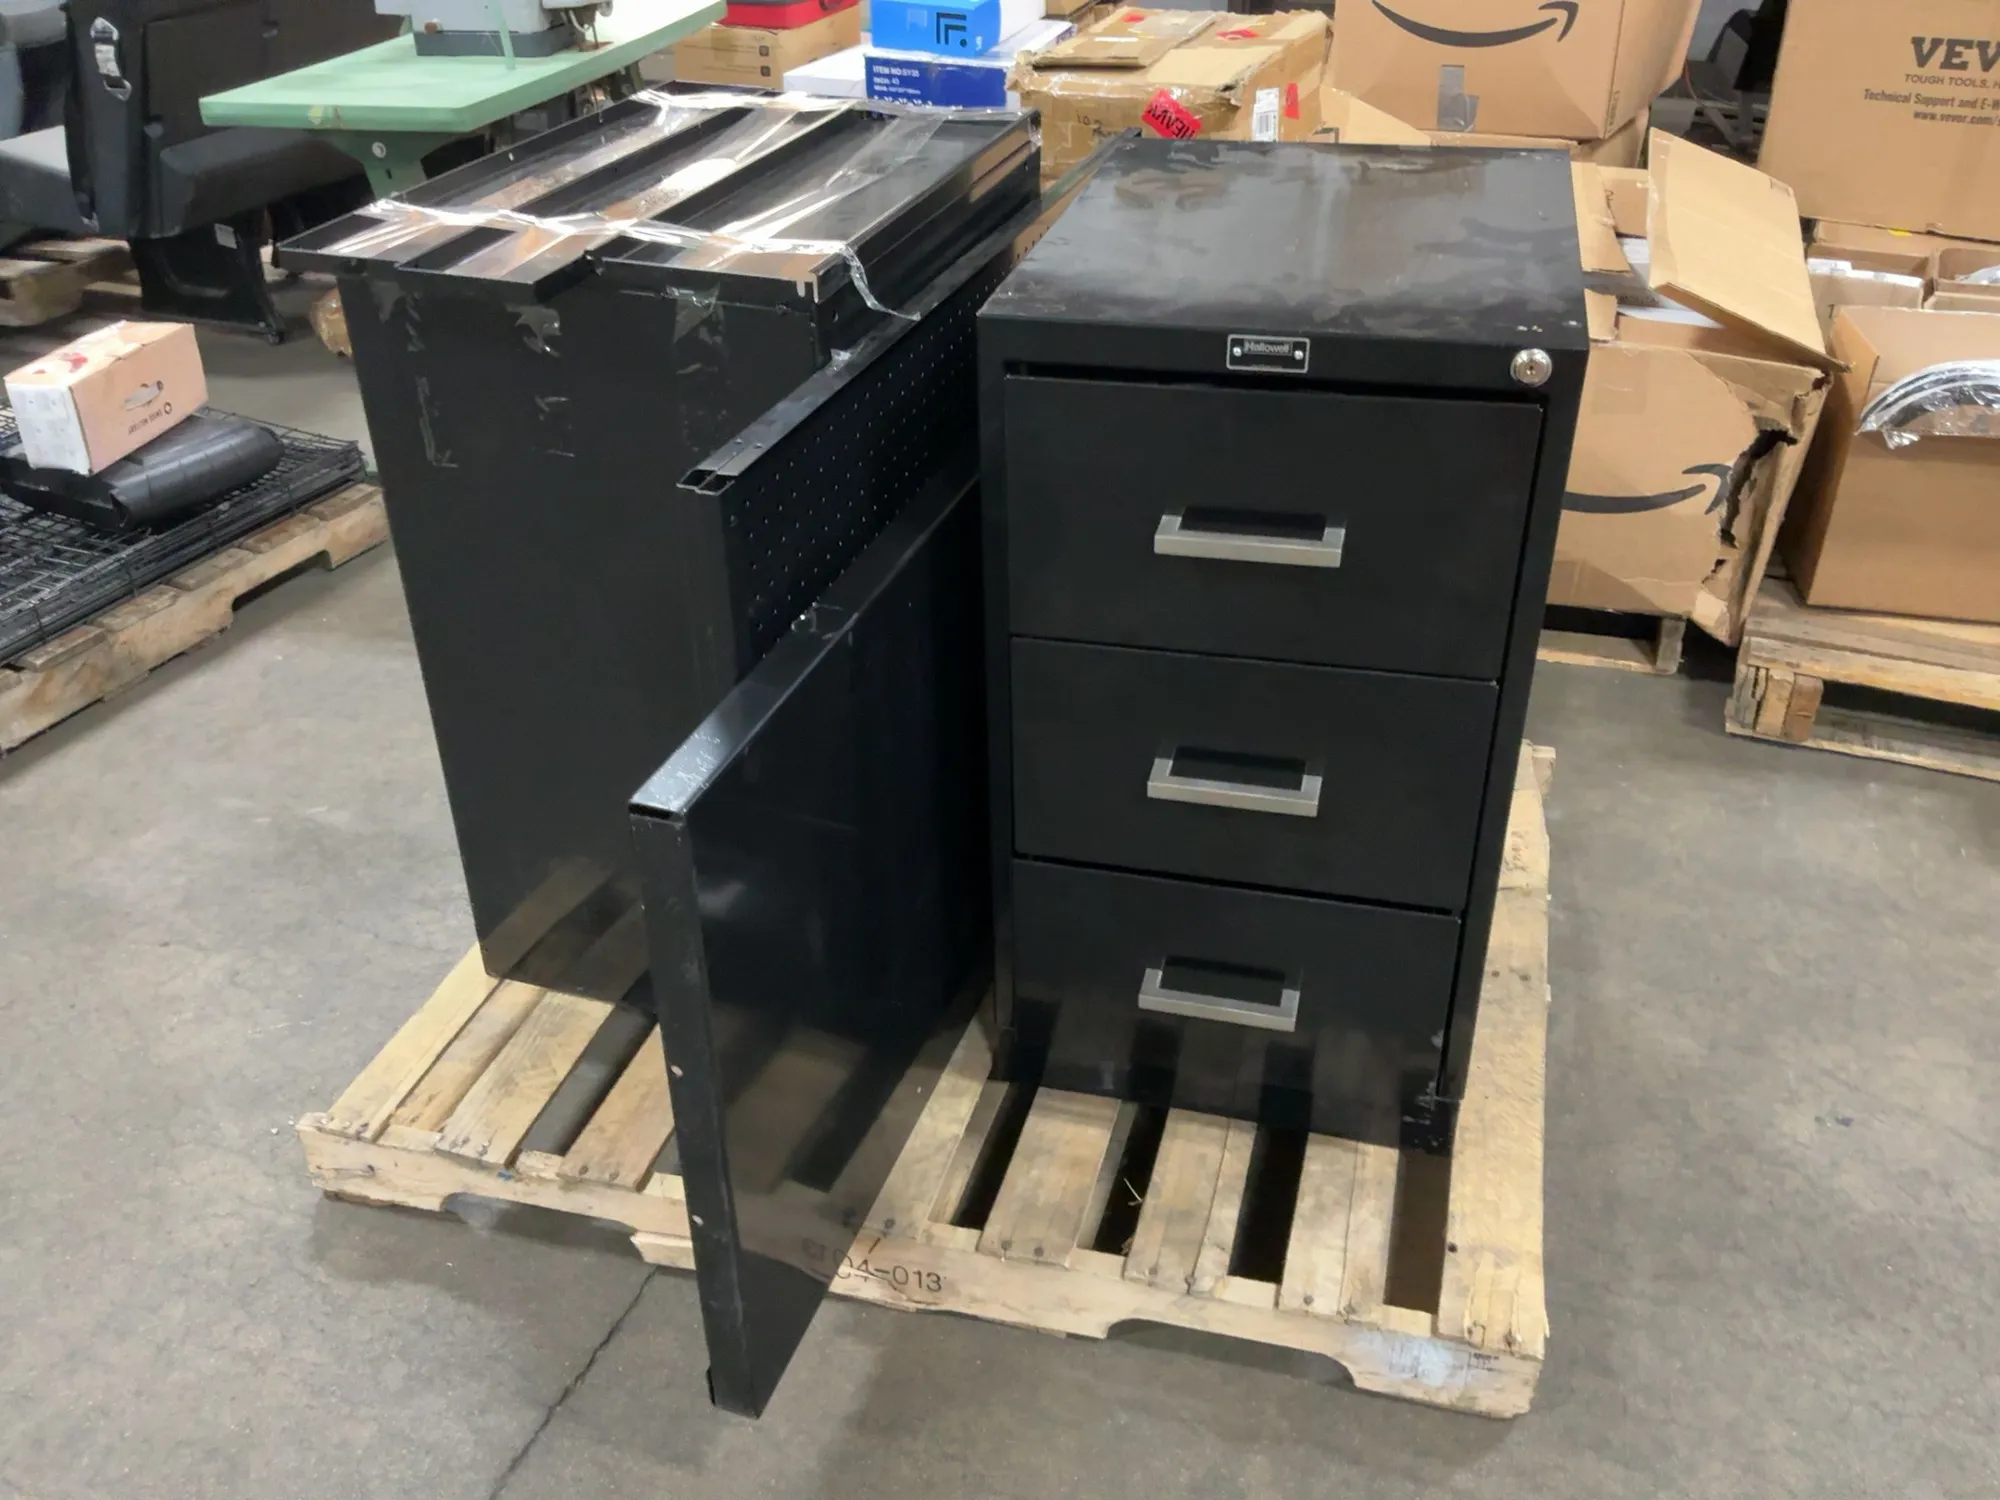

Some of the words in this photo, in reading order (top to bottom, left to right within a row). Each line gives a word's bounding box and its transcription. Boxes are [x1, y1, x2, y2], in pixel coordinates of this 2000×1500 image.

[1904, 73, 1945, 86] TOUGH
[1863, 89, 1912, 103] Technical
[1914, 93, 1955, 108] Support
[1957, 97, 1978, 109] and
